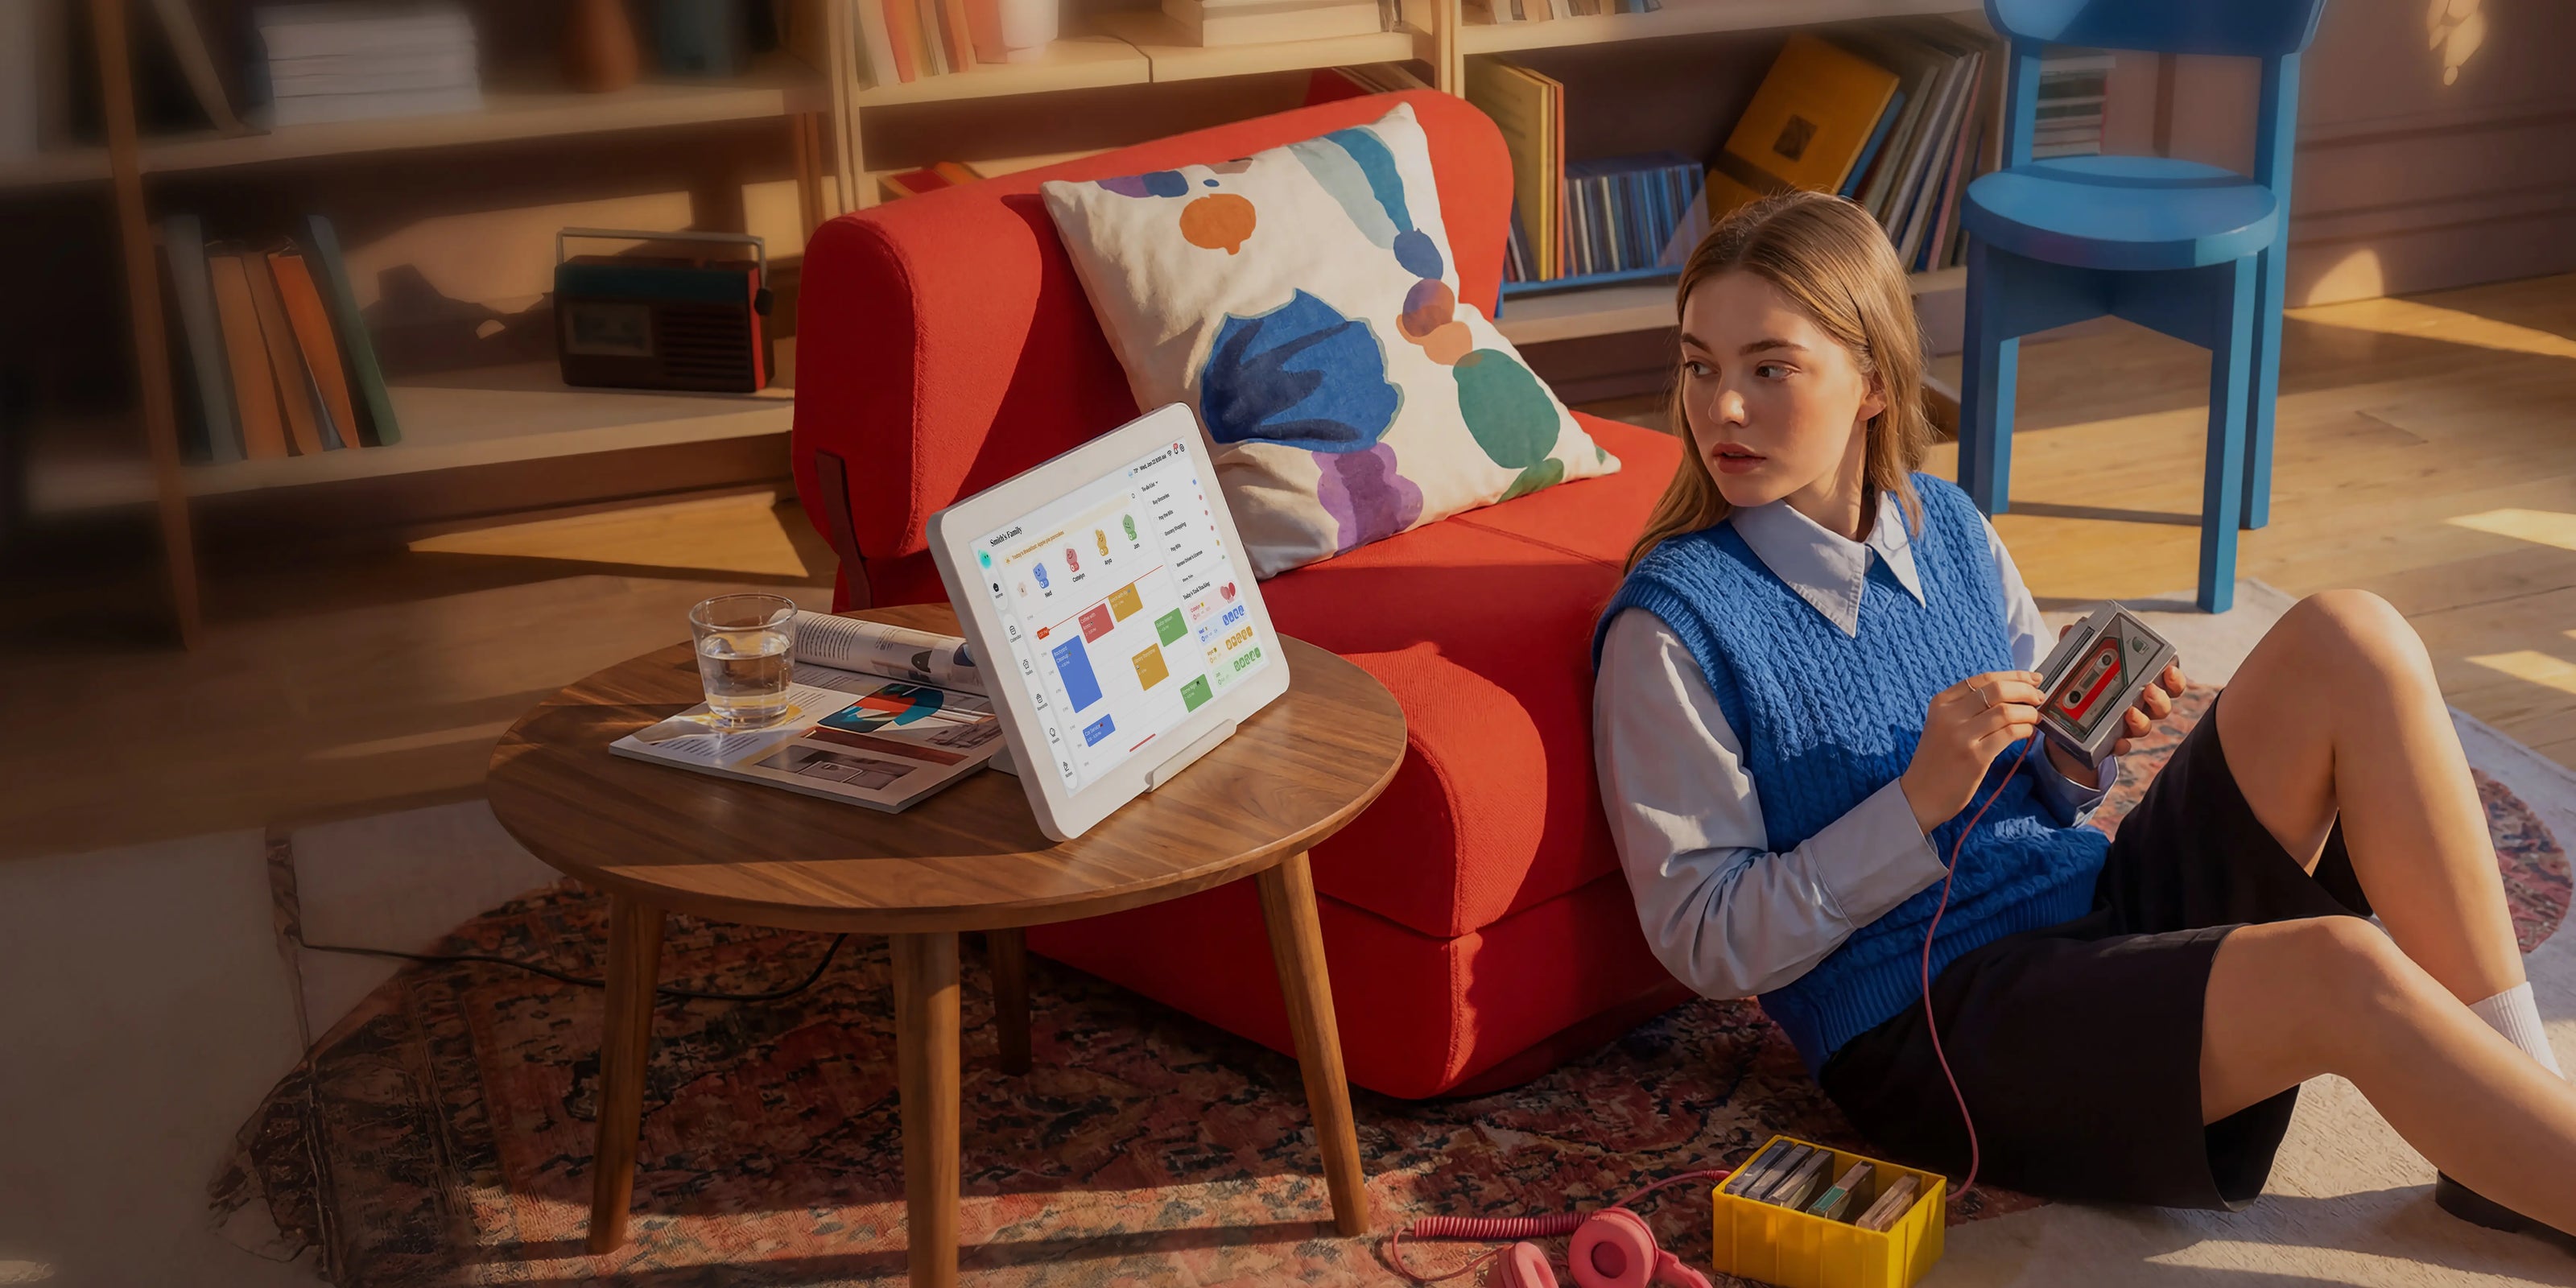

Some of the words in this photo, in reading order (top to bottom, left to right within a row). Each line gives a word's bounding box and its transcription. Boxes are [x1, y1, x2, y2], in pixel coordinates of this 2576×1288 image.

[1158, 493, 1169, 502] Groceries
[1174, 522, 1186, 530] Shopping
[990, 534, 1007, 547] Smith's
[1007, 526, 1022, 539] Family
[1072, 573, 1085, 583] Catelyn
[1010, 634, 1021, 642] Calendar
[1054, 646, 1067, 657] Backyard
